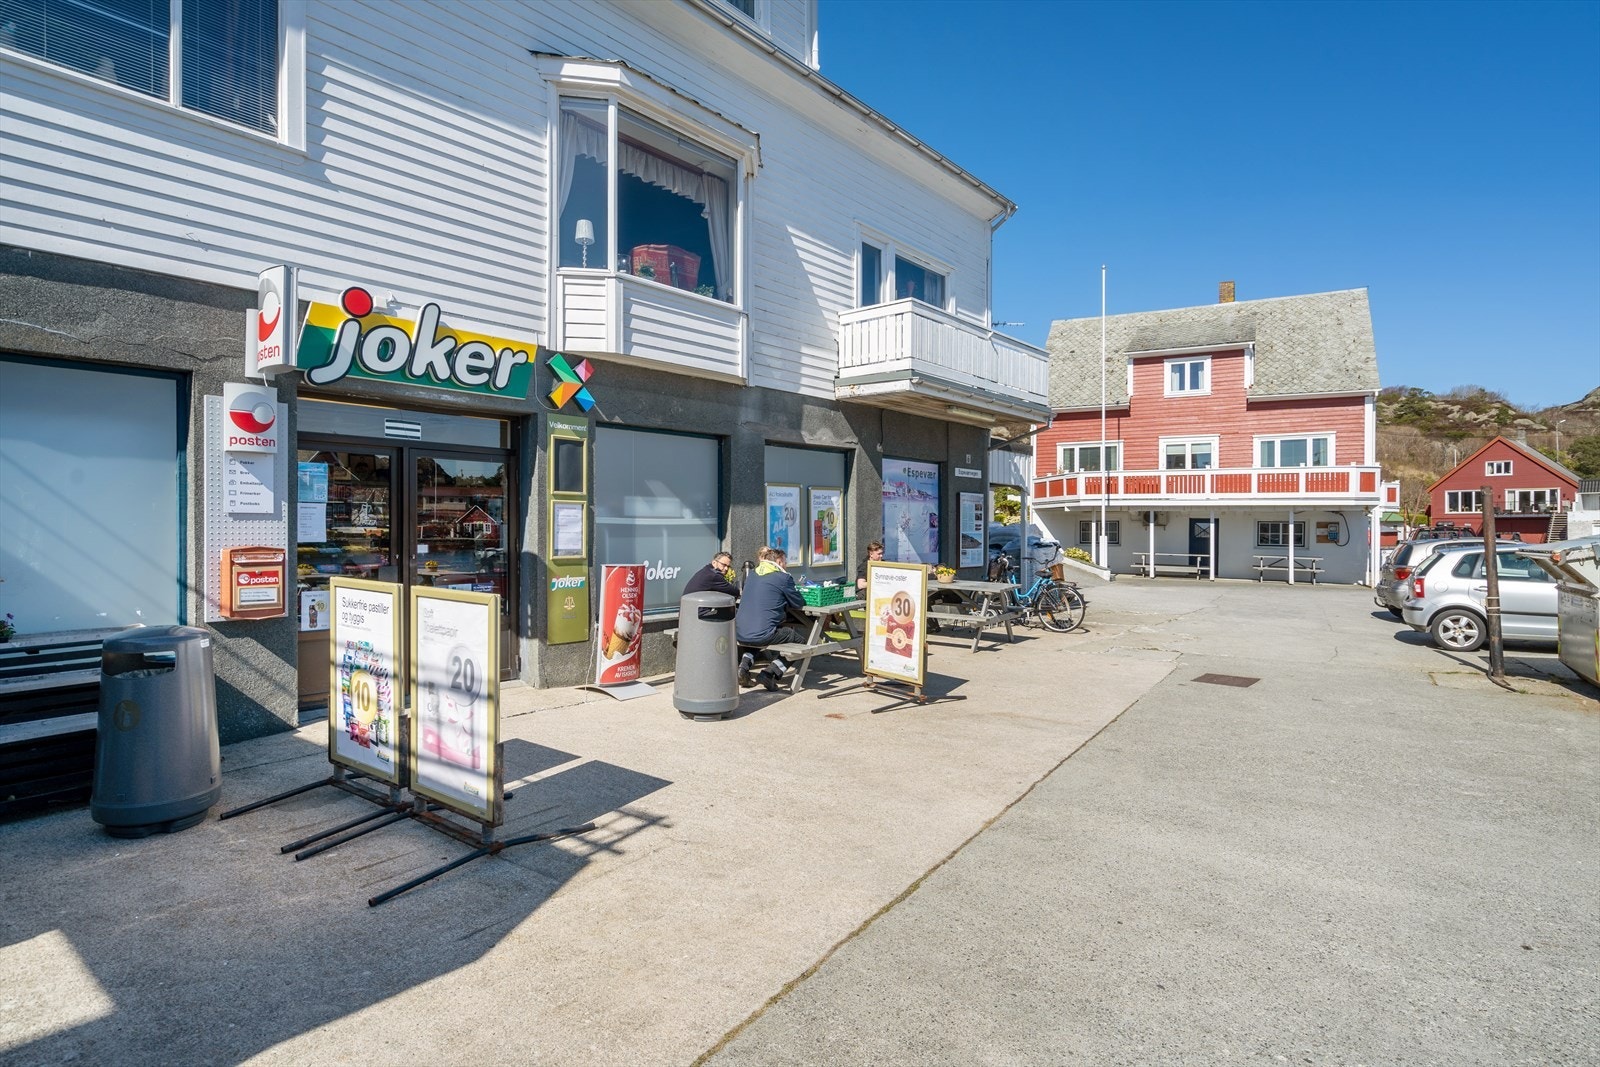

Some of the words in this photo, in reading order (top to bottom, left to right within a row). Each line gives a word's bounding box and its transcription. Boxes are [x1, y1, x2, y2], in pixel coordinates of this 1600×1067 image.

[304, 286, 529, 391] joker
[229, 435, 276, 448] posten
[784, 506, 795, 521] 20
[826, 511, 835, 525] 10
[643, 560, 681, 580] oker
[250, 576, 279, 585] posten
[550, 574, 585, 591] joker
[342, 596, 368, 611] Sukkerfrie
[368, 603, 390, 615] pastiller
[894, 597, 911, 617] 30
[341, 611, 348, 623] og
[349, 612, 365, 626] tyggis
[450, 655, 475, 693] 20
[354, 680, 370, 712] 10
